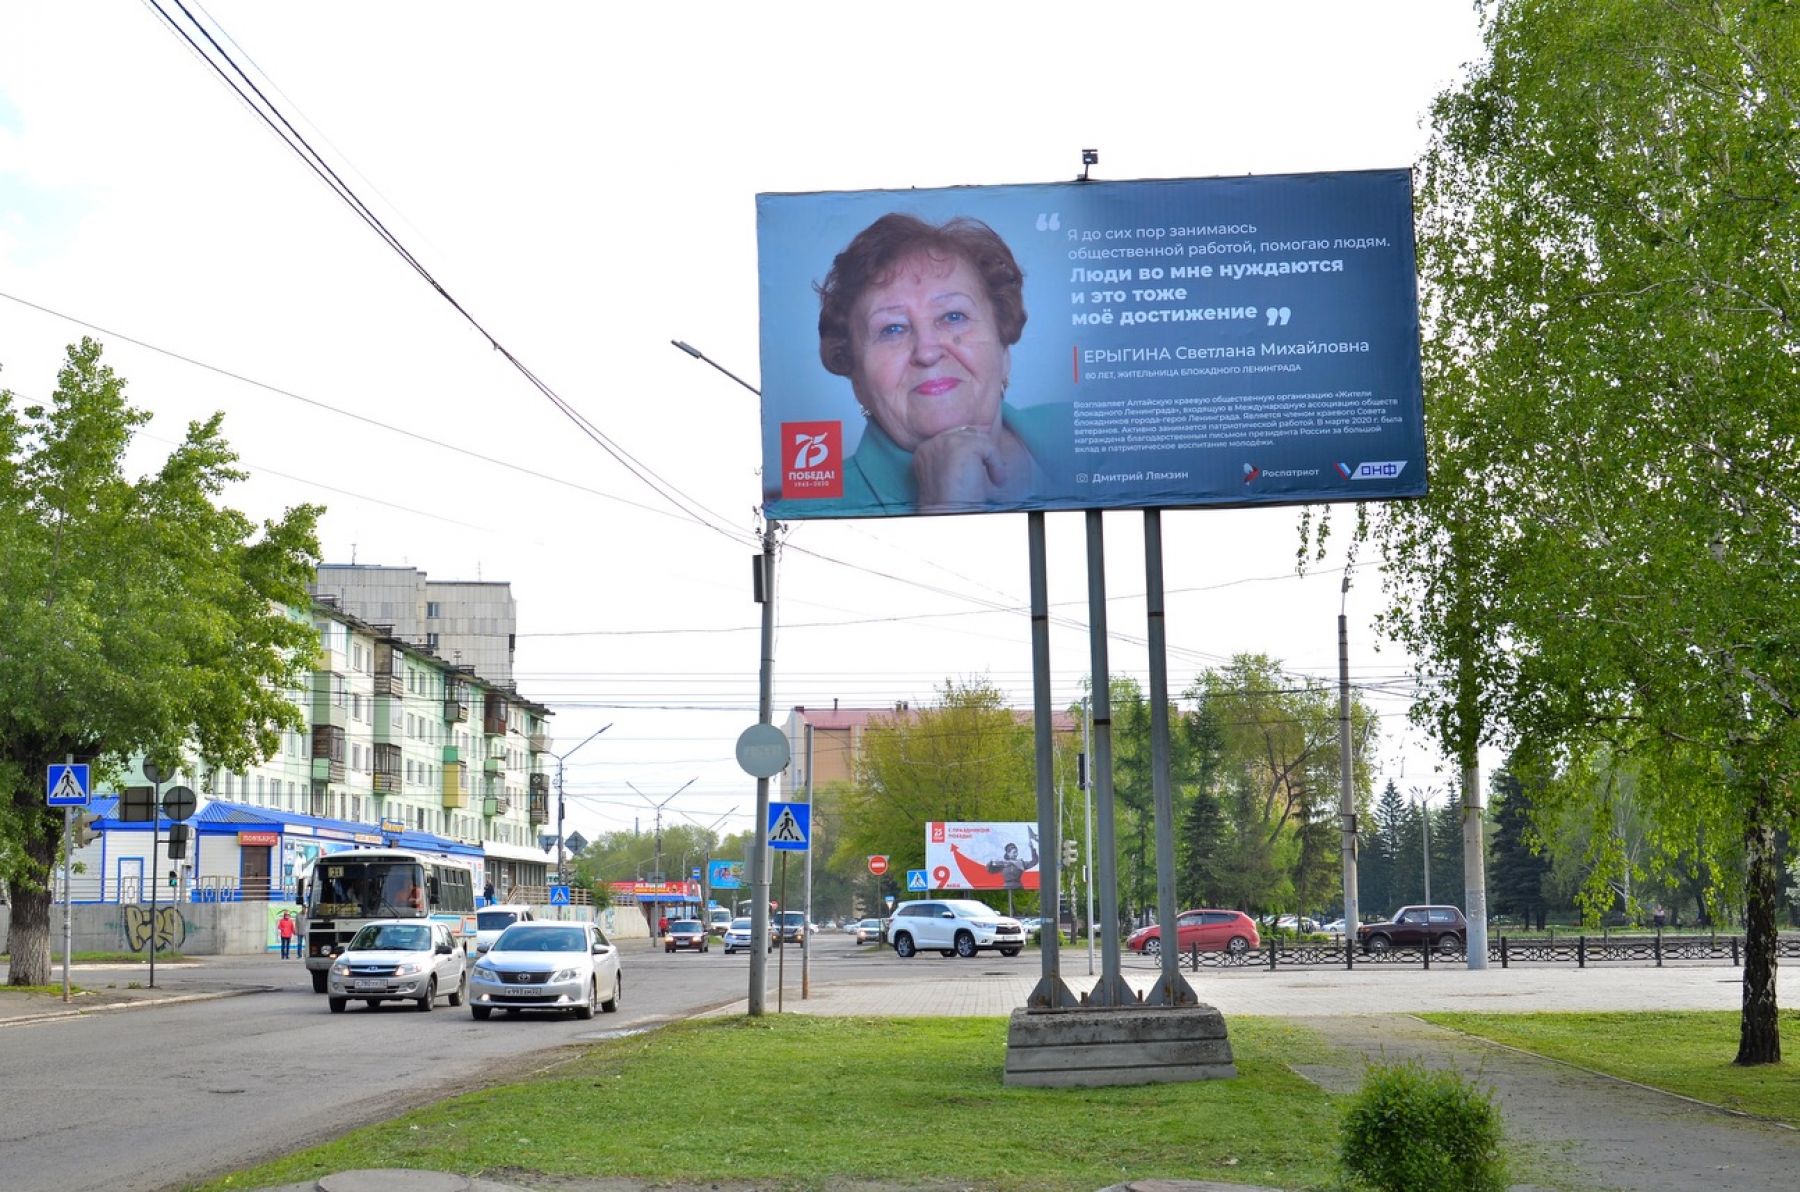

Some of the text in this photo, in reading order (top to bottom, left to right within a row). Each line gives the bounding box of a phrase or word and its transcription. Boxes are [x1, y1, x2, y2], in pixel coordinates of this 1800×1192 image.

[1067, 229, 1077, 241] Я
[1081, 230, 1101, 242] до
[1106, 228, 1132, 239] сих
[1136, 227, 1166, 240] пор
[1169, 223, 1257, 237] занимаюсь
[1067, 237, 1391, 261] общественной работой, помогаю людям.
[1070, 259, 1344, 284] Люди во мне нуждаются
[1071, 287, 1188, 304] и это тоже
[1071, 308, 1114, 326] моё
[1120, 306, 1257, 326] достижение
[1084, 340, 1370, 363] ЕРЫГИНА Светлана Михайловна
[1098, 371, 1116, 380] ЛЕТ,
[1117, 368, 1179, 379] ЖИТЕЛЬНИЦА
[1181, 366, 1240, 377] БЛОКАДНОГО
[1241, 363, 1302, 374] ЛЕНИНГРАДА
[1127, 398, 1173, 408] Алтайскую
[794, 431, 829, 469] 75
[788, 470, 835, 481] ПОБЕДА!
[1091, 469, 1189, 484] Дмитрий Лямзин
[1262, 467, 1320, 479] Роспатриот
[1361, 463, 1398, 477] ОНФ
[933, 865, 951, 889] 9
